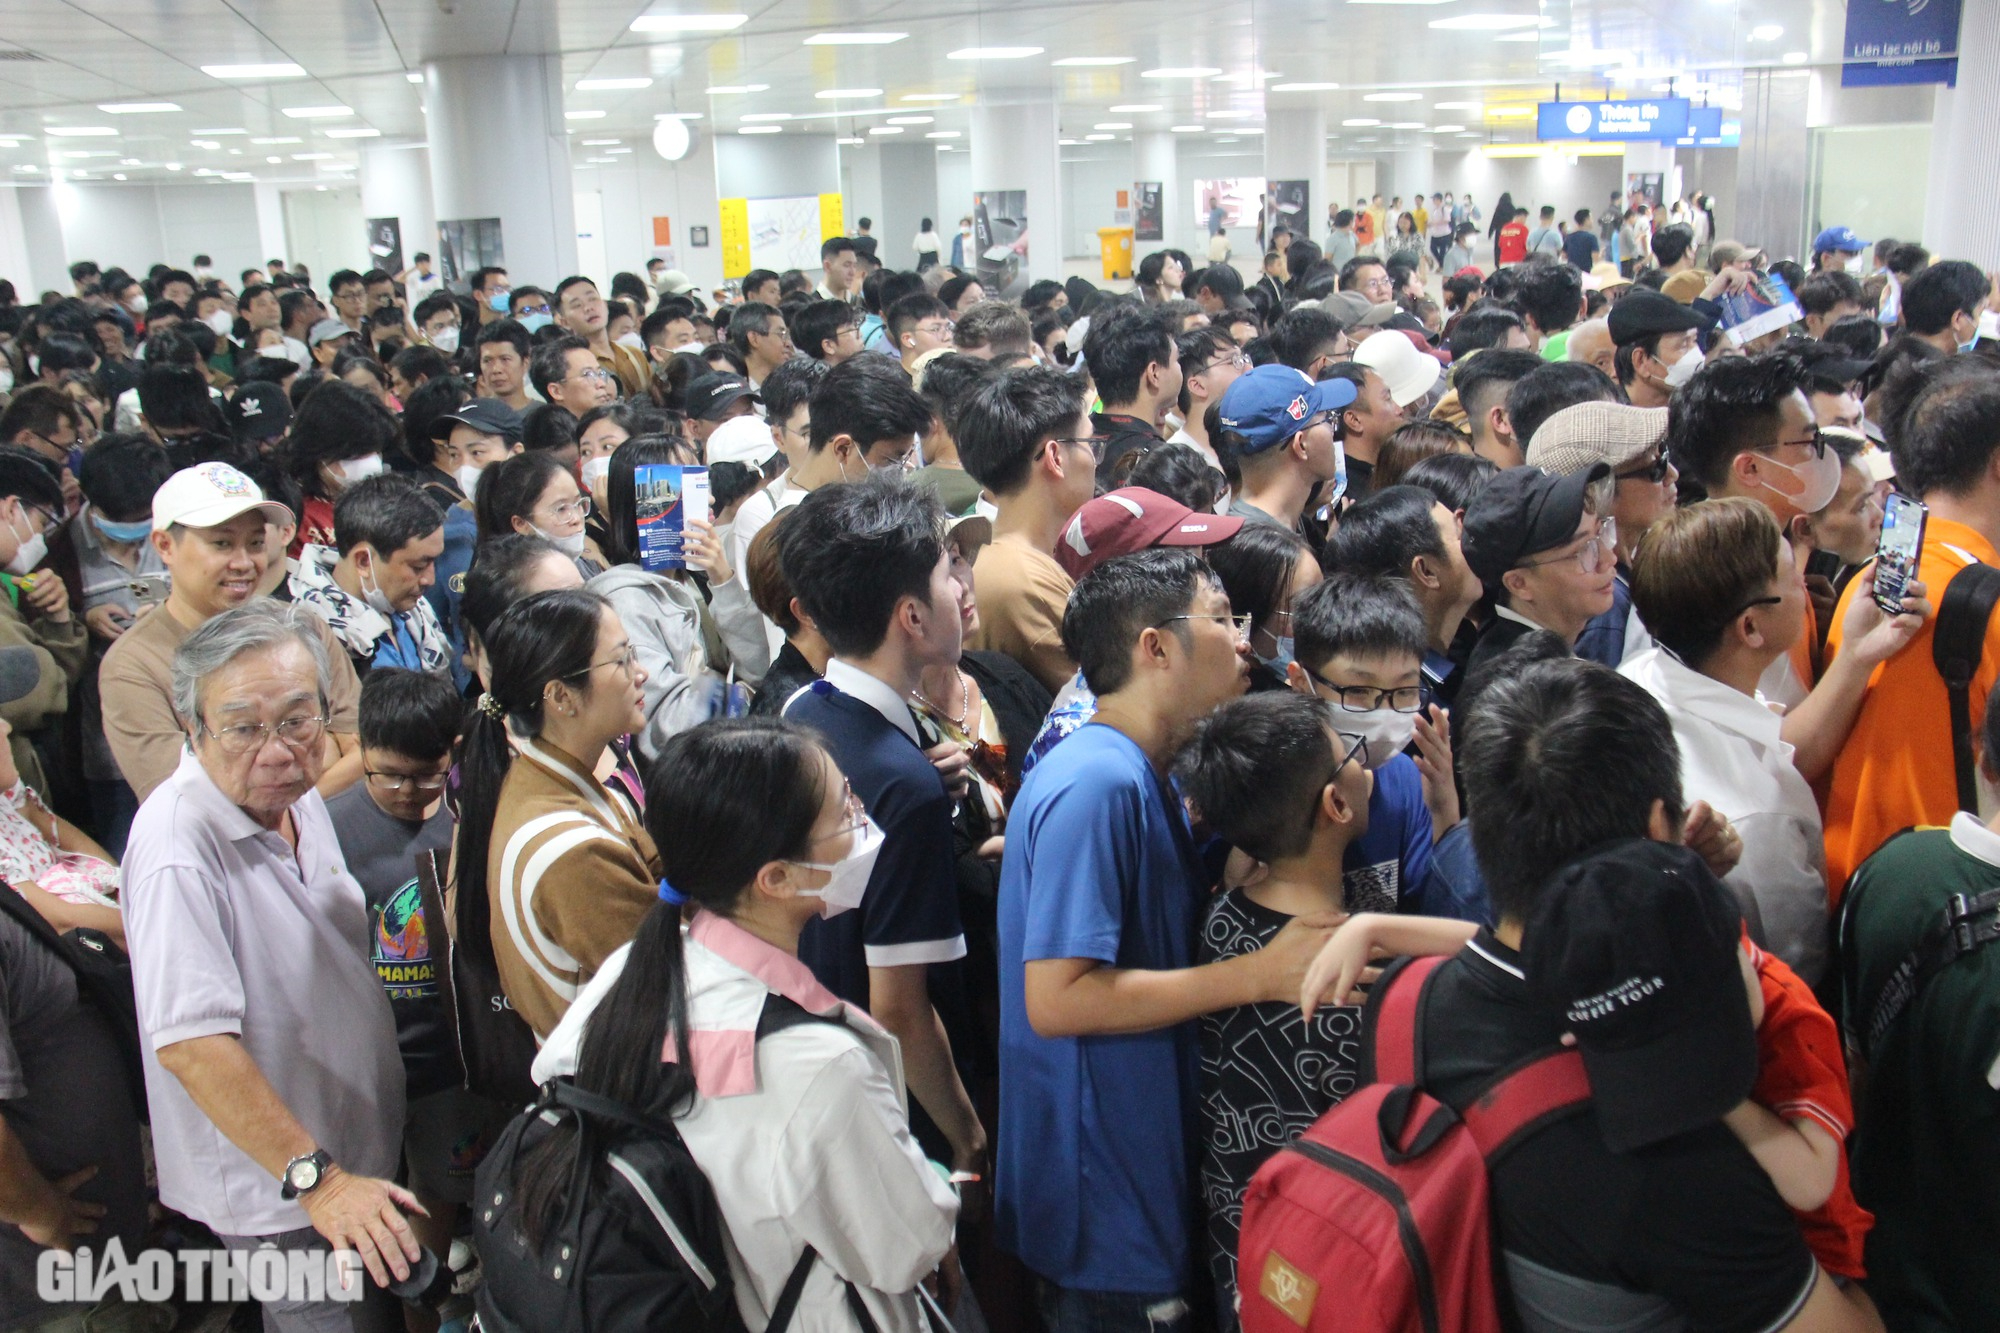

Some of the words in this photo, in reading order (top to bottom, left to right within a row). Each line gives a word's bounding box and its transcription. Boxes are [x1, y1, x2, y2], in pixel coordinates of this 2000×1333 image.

[1854, 43, 1880, 57] Liên
[377, 964, 434, 981] MAMA
[1619, 976, 1665, 1006] TOUR
